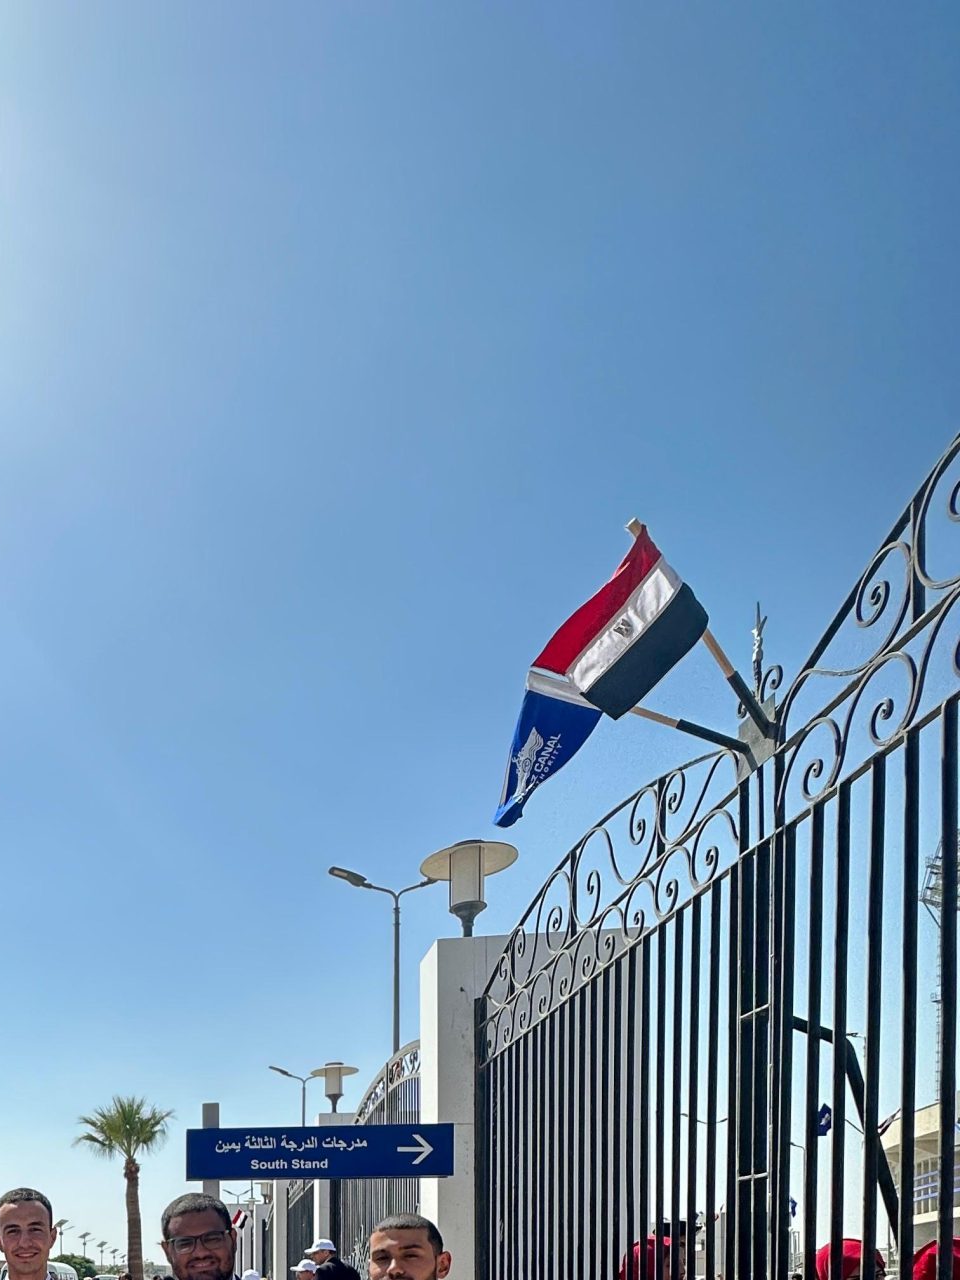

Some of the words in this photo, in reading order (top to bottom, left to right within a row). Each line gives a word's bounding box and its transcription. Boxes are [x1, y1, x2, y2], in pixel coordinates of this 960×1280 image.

[534, 733, 561, 772] CANAL
[532, 743, 562, 788] THORITY
[215, 1140, 241, 1152] يمين
[245, 1135, 277, 1149] الثالثة
[281, 1135, 318, 1152] الدرجة
[322, 1136, 368, 1151] مدرجات
[251, 1159, 288, 1170] South
[291, 1158, 329, 1169] Stand
